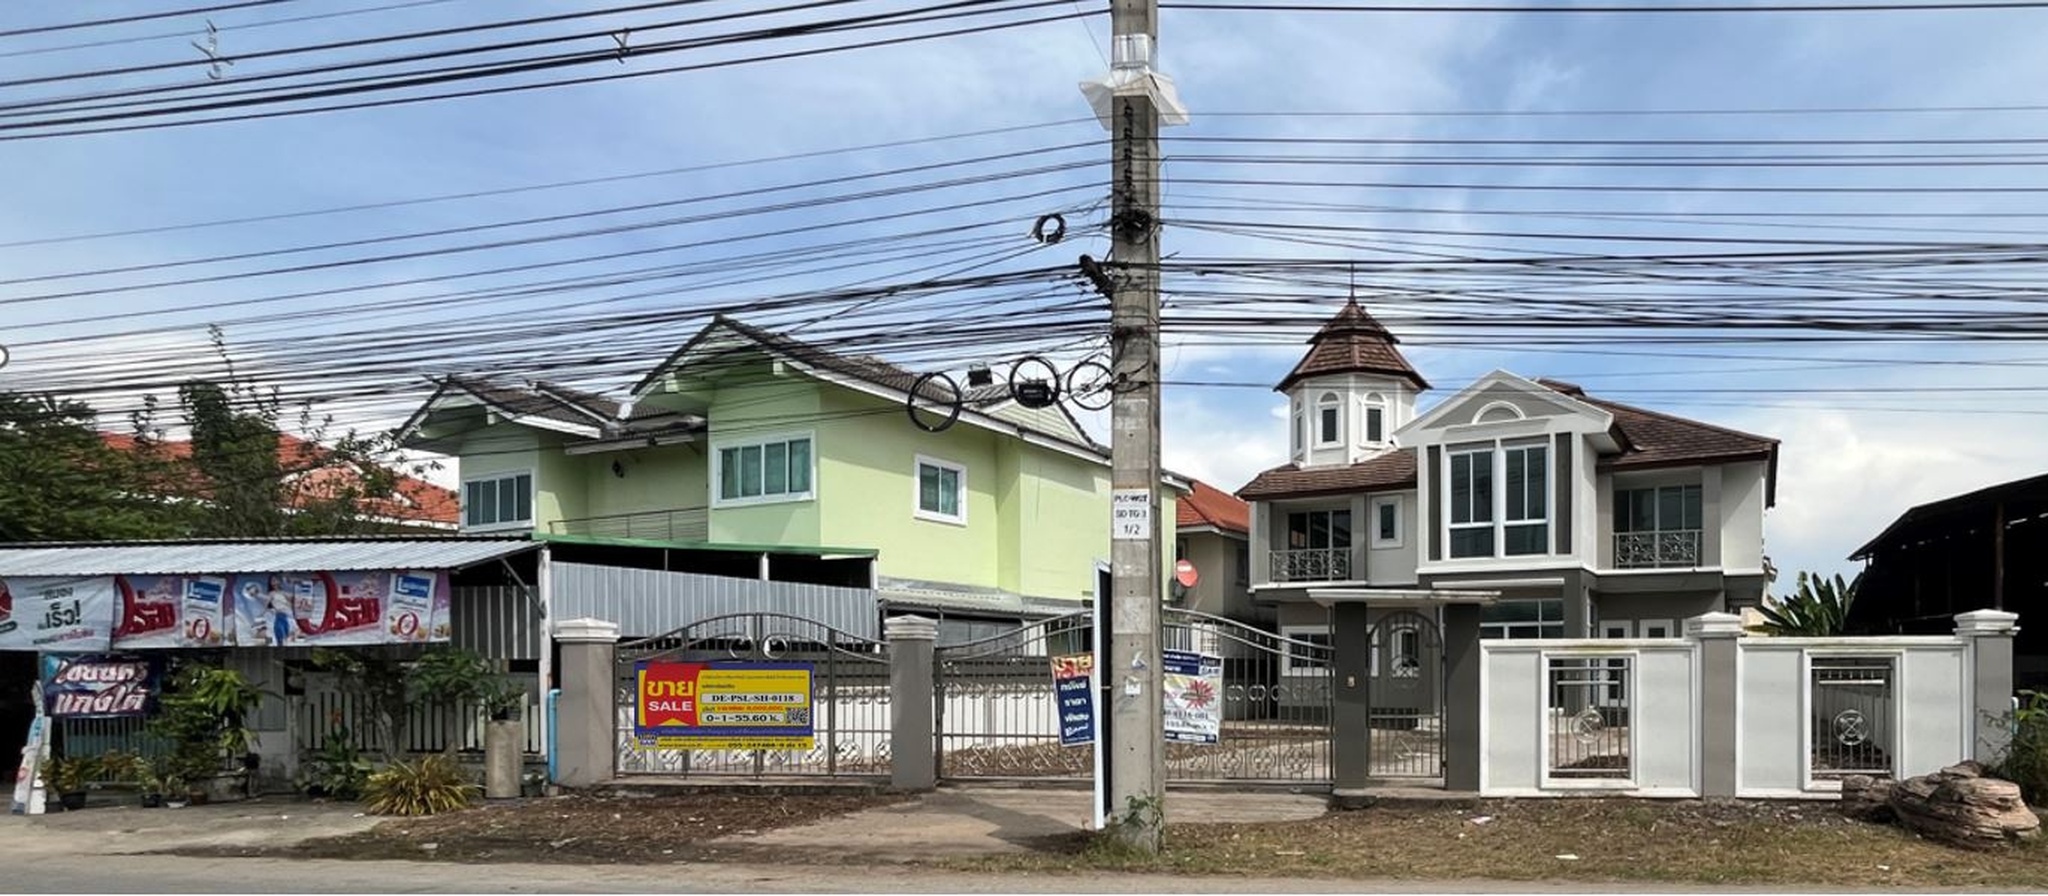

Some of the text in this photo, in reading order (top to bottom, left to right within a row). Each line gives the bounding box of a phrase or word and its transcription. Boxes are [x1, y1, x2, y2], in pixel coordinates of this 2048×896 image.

[1124, 523, 1141, 535] 1/2
[647, 681, 694, 697] ขาย
[648, 701, 693, 712] SALE
